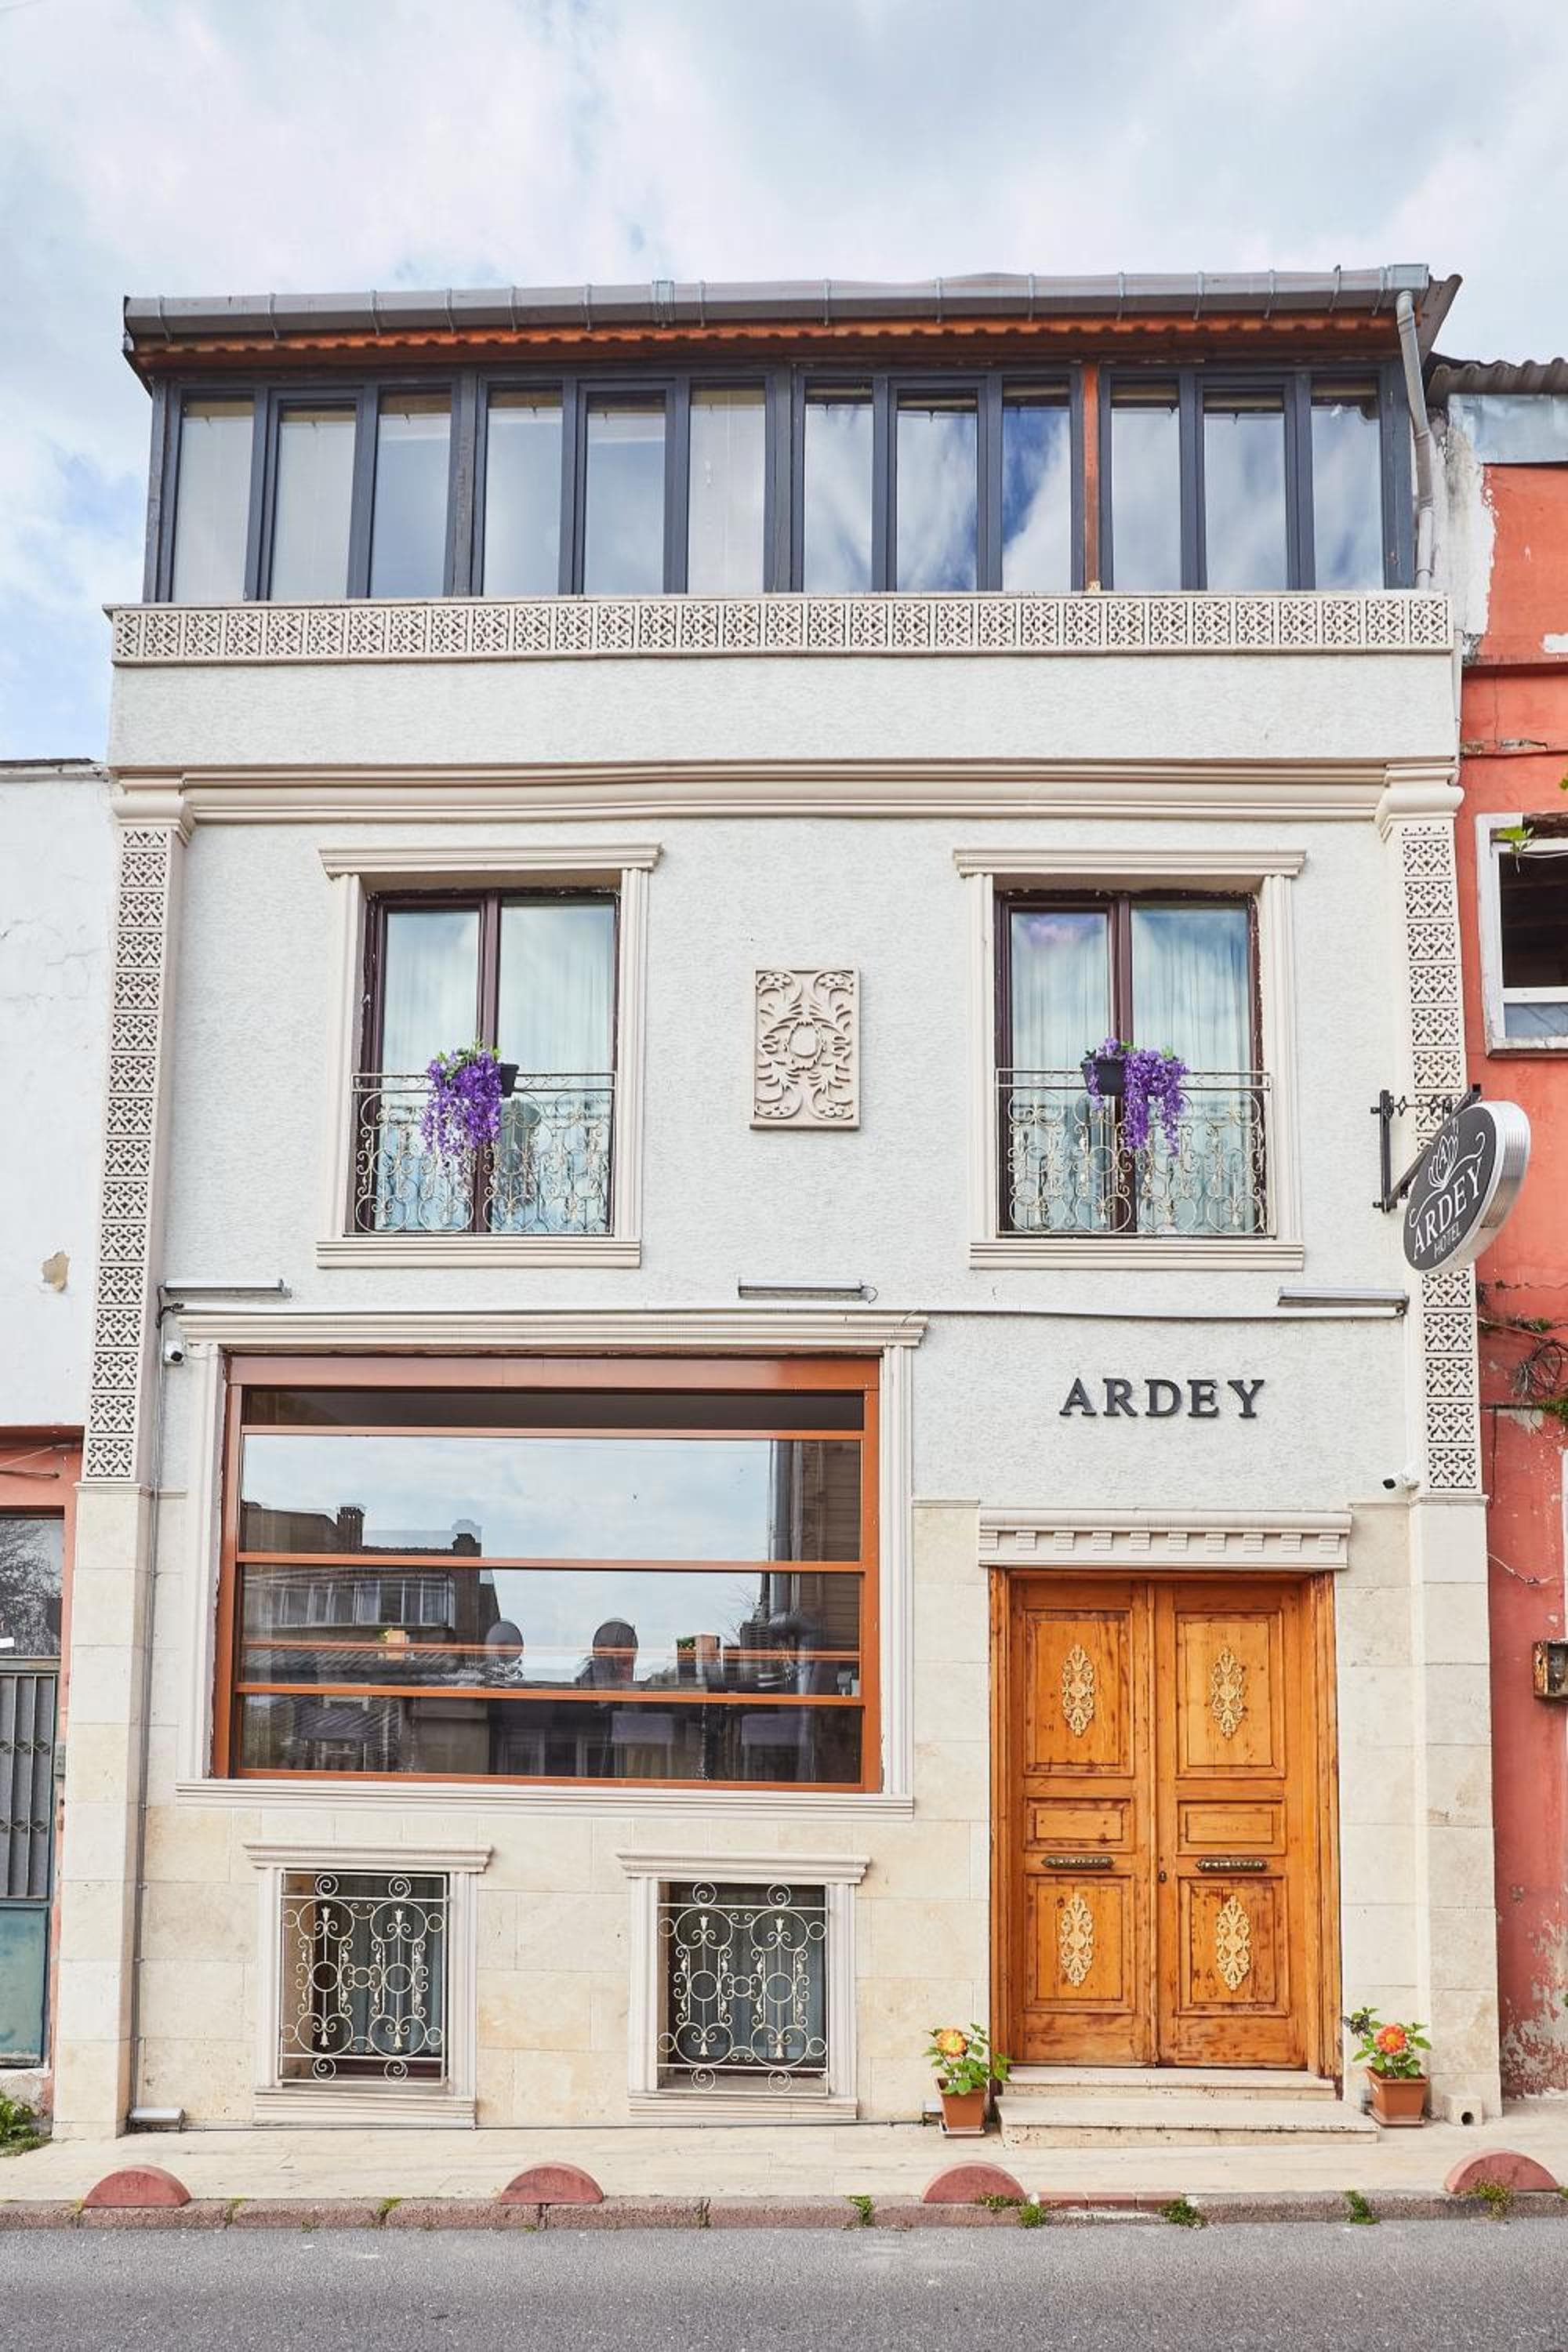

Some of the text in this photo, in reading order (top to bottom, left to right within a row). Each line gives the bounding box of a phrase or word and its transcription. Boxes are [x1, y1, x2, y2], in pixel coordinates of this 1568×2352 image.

[1414, 1156, 1482, 1261] ARDEY
[1434, 1221, 1461, 1259] HOTEL
[1059, 1377, 1265, 1417] ARDEY
